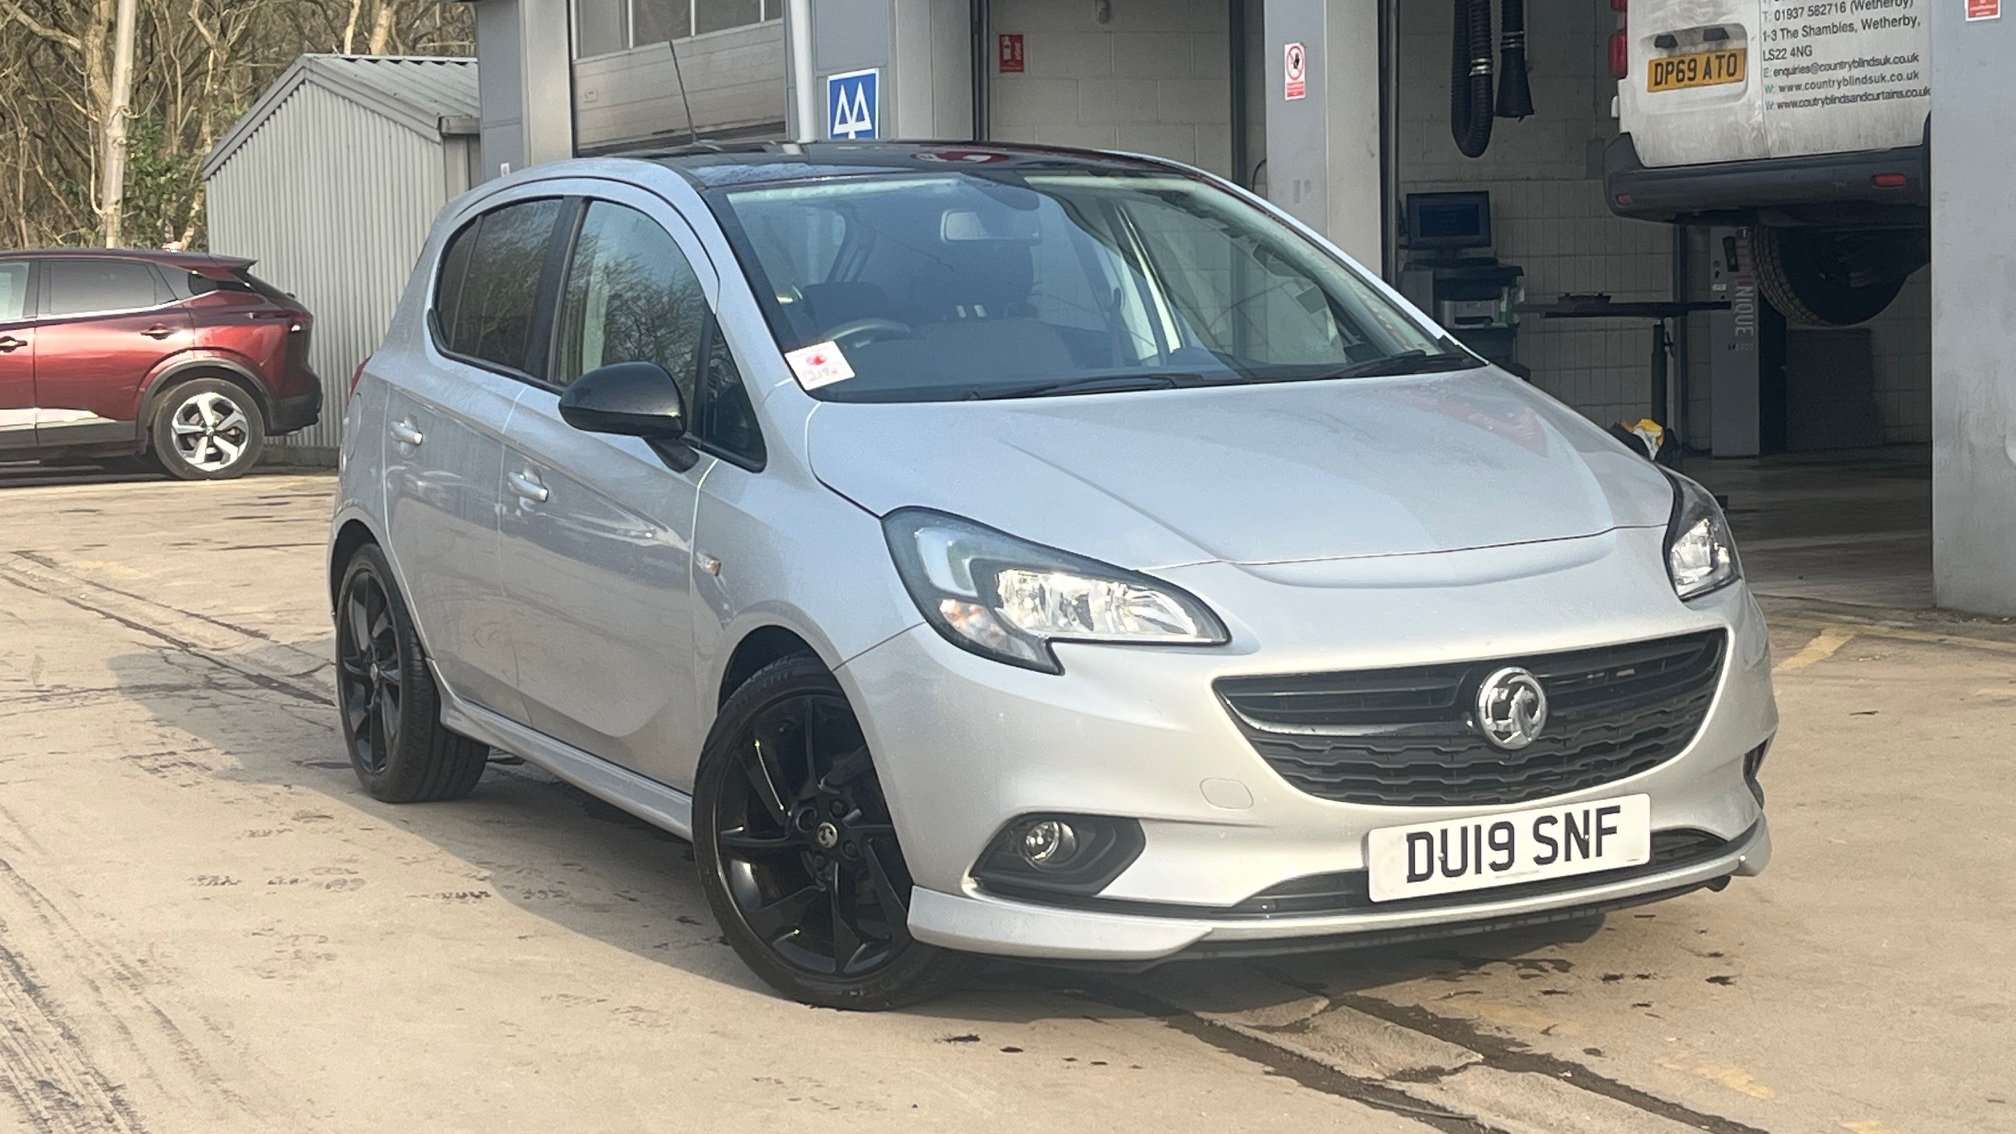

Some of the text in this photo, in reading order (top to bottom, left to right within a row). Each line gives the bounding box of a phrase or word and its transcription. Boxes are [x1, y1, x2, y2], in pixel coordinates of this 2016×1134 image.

[1774, 7, 1805, 21] 01937
[1762, 14, 1920, 42] 1-3 The Shambles, Wetherby,
[1763, 44, 1813, 61] LS22 4NG
[1773, 52, 1920, 79] enquiries@countryblindsuk.co.uk
[1654, 53, 1737, 86] DP69 ATO
[1778, 70, 1920, 93] www.countryblindsuk.co.uk
[1406, 804, 1621, 884] DU19 SNF
